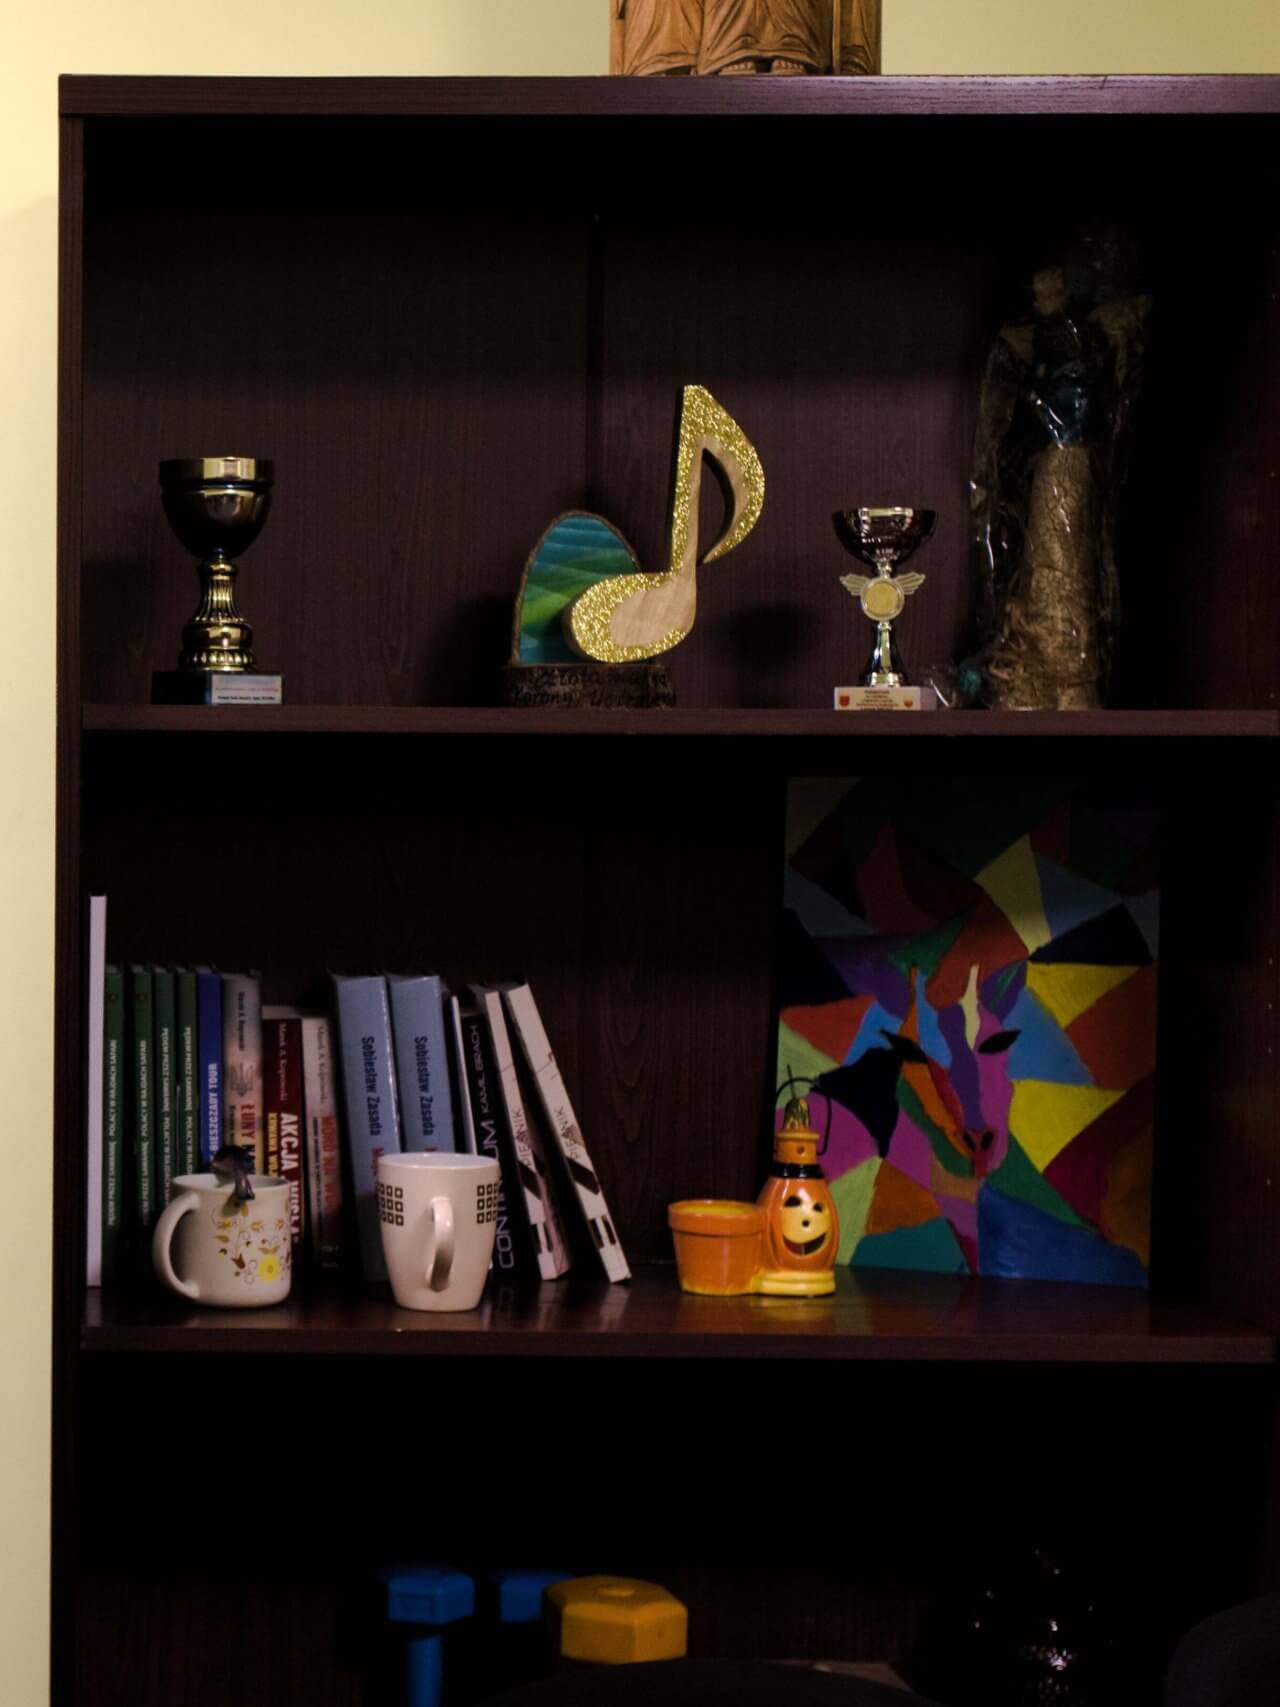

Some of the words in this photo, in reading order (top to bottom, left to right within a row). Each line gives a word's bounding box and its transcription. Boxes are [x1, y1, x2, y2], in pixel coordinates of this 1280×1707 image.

[361, 1035, 379, 1093] Sobiesław
[414, 1035, 431, 1093] Sobiesław
[470, 1024, 484, 1071] BRACH
[208, 1063, 218, 1089] TOUR
[477, 1073, 490, 1114] KAMIL
[240, 1104, 256, 1139] ŁUNY
[366, 1095, 383, 1136] Zasada
[419, 1095, 436, 1136] Zasada
[280, 1112, 299, 1171] AKCJA
